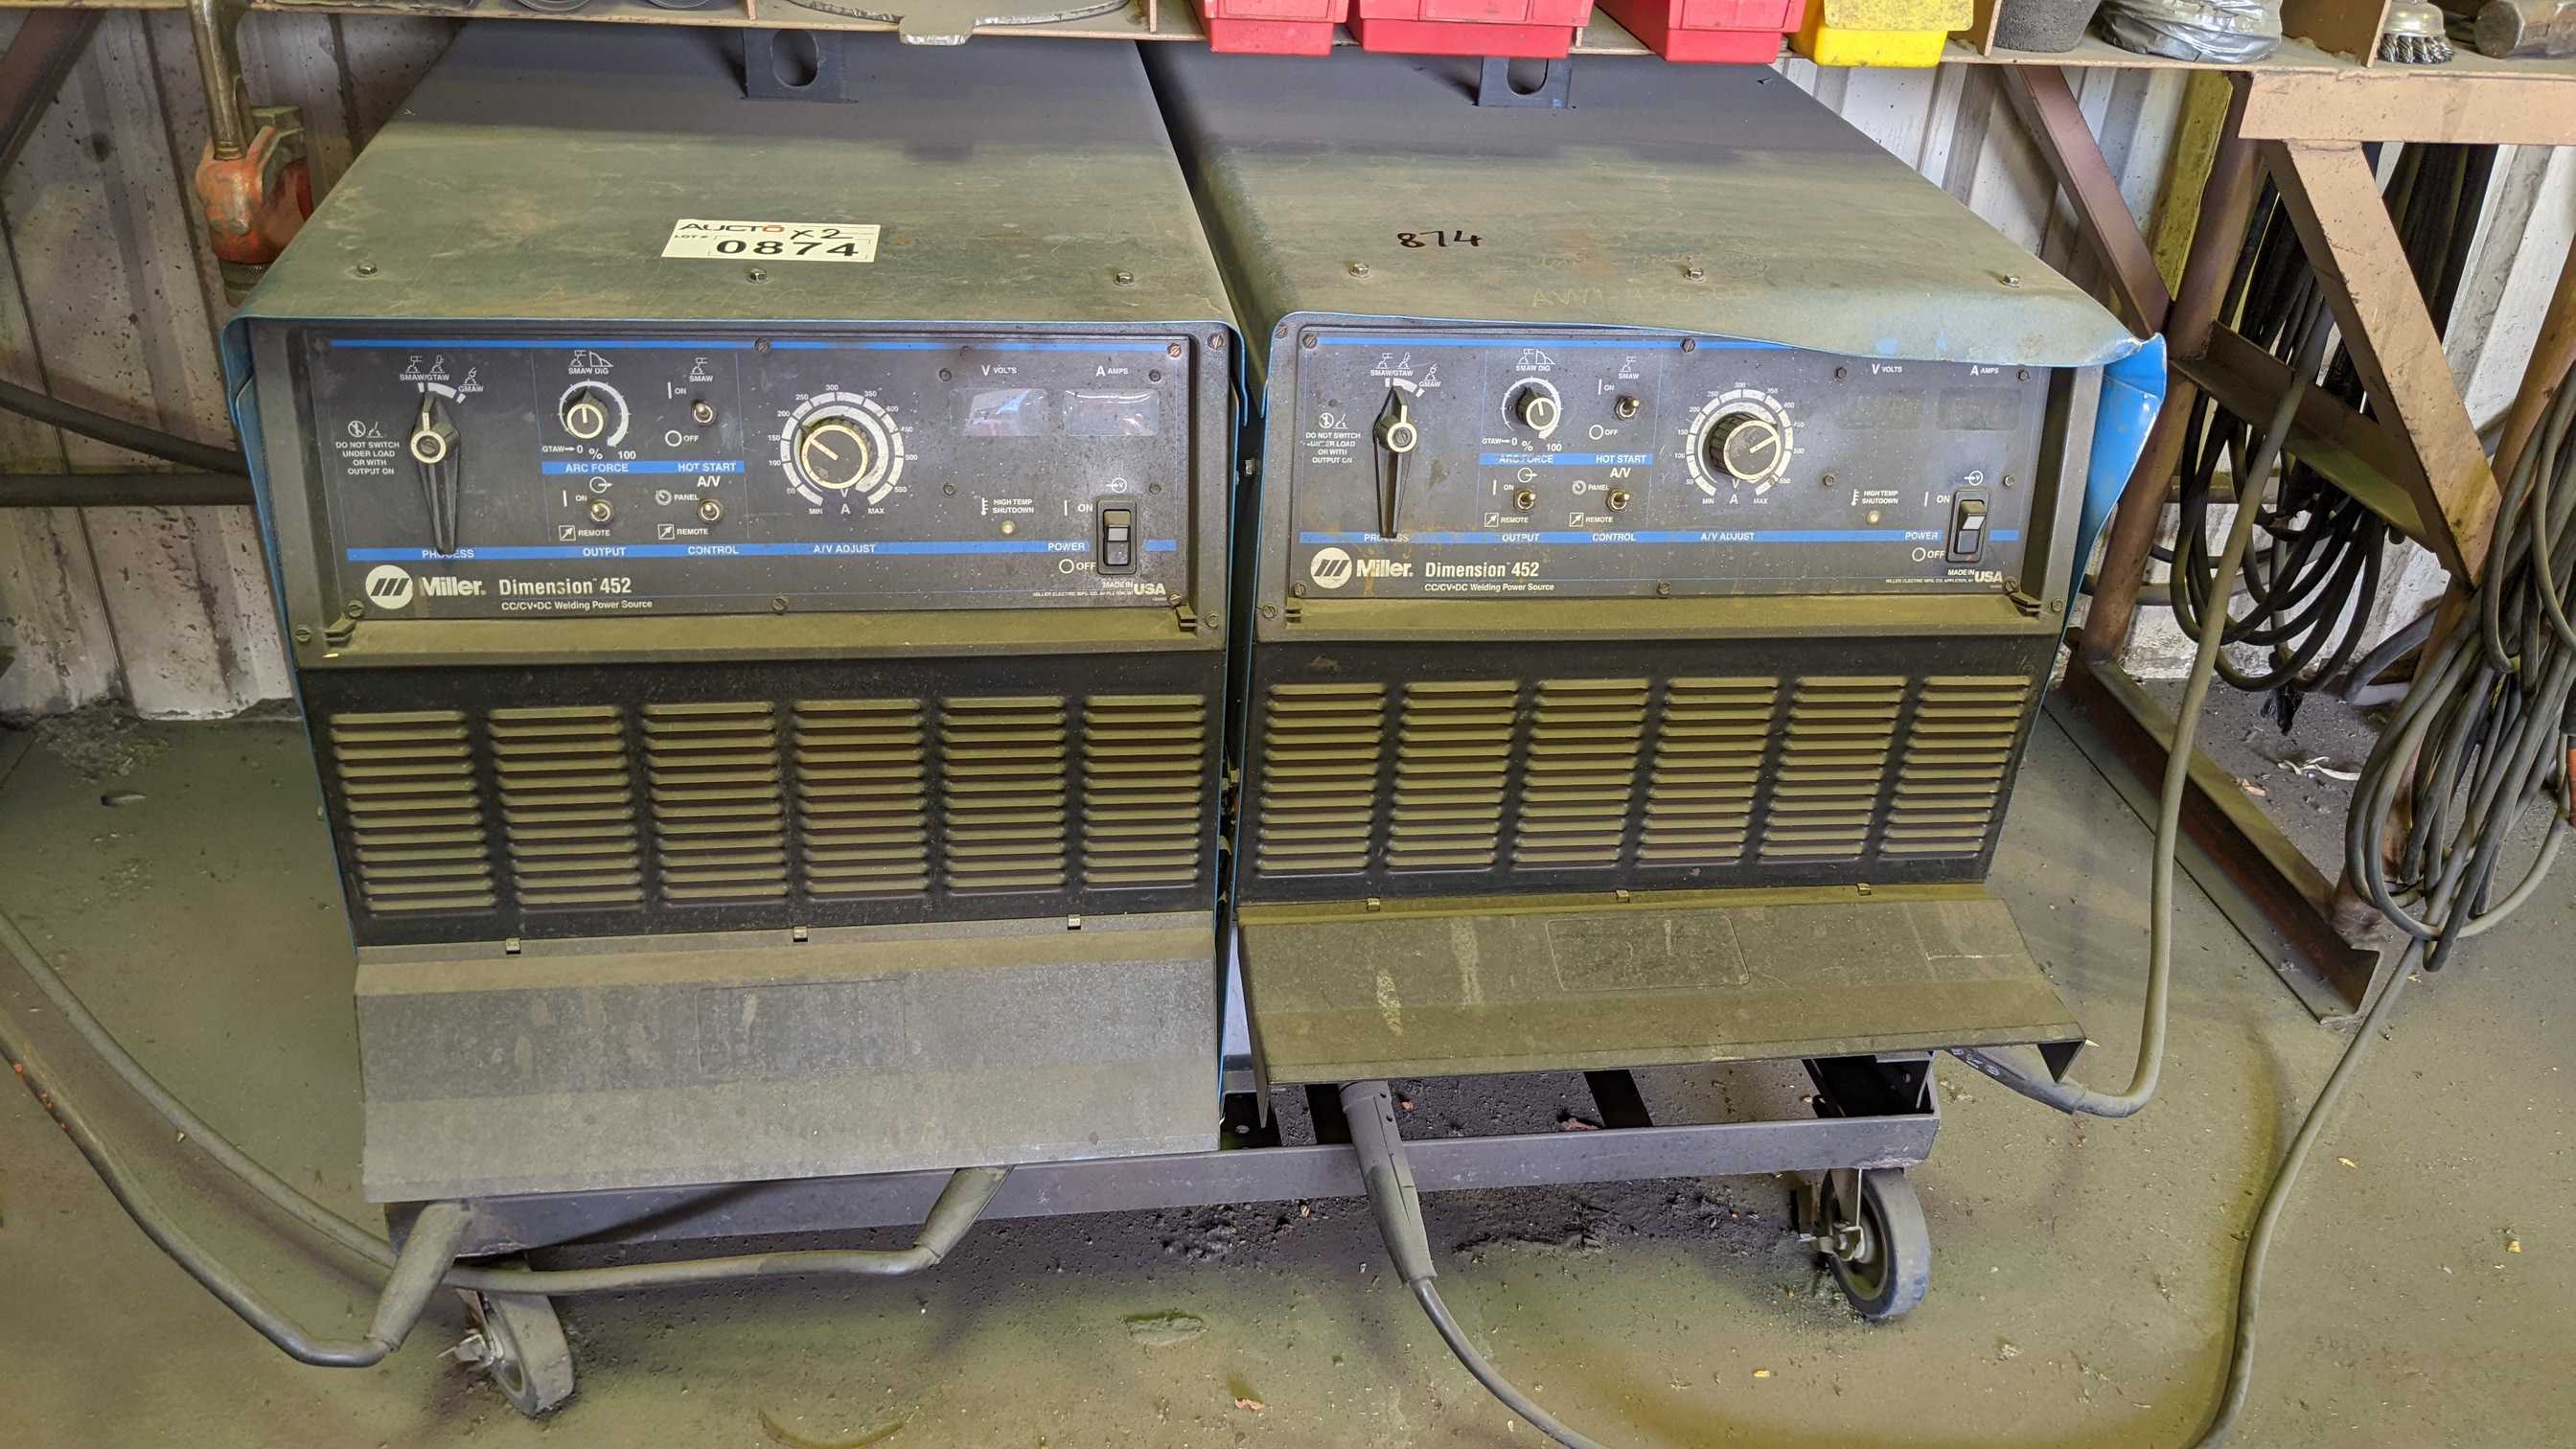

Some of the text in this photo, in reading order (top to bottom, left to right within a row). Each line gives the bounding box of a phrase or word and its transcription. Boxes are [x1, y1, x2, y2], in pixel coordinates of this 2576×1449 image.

[678, 222, 785, 232] AUCTO
[1396, 230, 1483, 248] 874
[717, 240, 859, 257] 0874
[980, 365, 1017, 376] V VOLTS
[1095, 365, 1106, 376] A
[1872, 364, 1880, 375] V
[1970, 365, 1979, 376] A
[576, 445, 584, 453] 0
[1522, 440, 1533, 451] %
[588, 448, 603, 460] %
[618, 451, 636, 460] 100
[1596, 454, 1646, 464] HOT START
[565, 463, 629, 472] ARC FORCE
[678, 463, 737, 472] HOT START
[1610, 468, 1631, 477] A/V
[697, 476, 721, 487] A/V
[1730, 494, 1738, 504] A
[840, 504, 851, 514] A
[687, 546, 739, 555] CONTROL
[814, 544, 834, 553] A/V
[1048, 542, 1085, 551] POWER
[583, 547, 627, 557] OUTPUT
[1076, 562, 1096, 570] OFF
[1511, 563, 1540, 577] 452
[1975, 571, 2003, 583] USA
[600, 578, 632, 594] 452
[1134, 583, 1166, 595] USA
[1470, 583, 1501, 592] Welding
[1503, 583, 1527, 591] Power
[1529, 583, 1554, 591] Source
[554, 600, 590, 611] Welding
[592, 600, 619, 610] Power
[621, 599, 653, 609] Source
